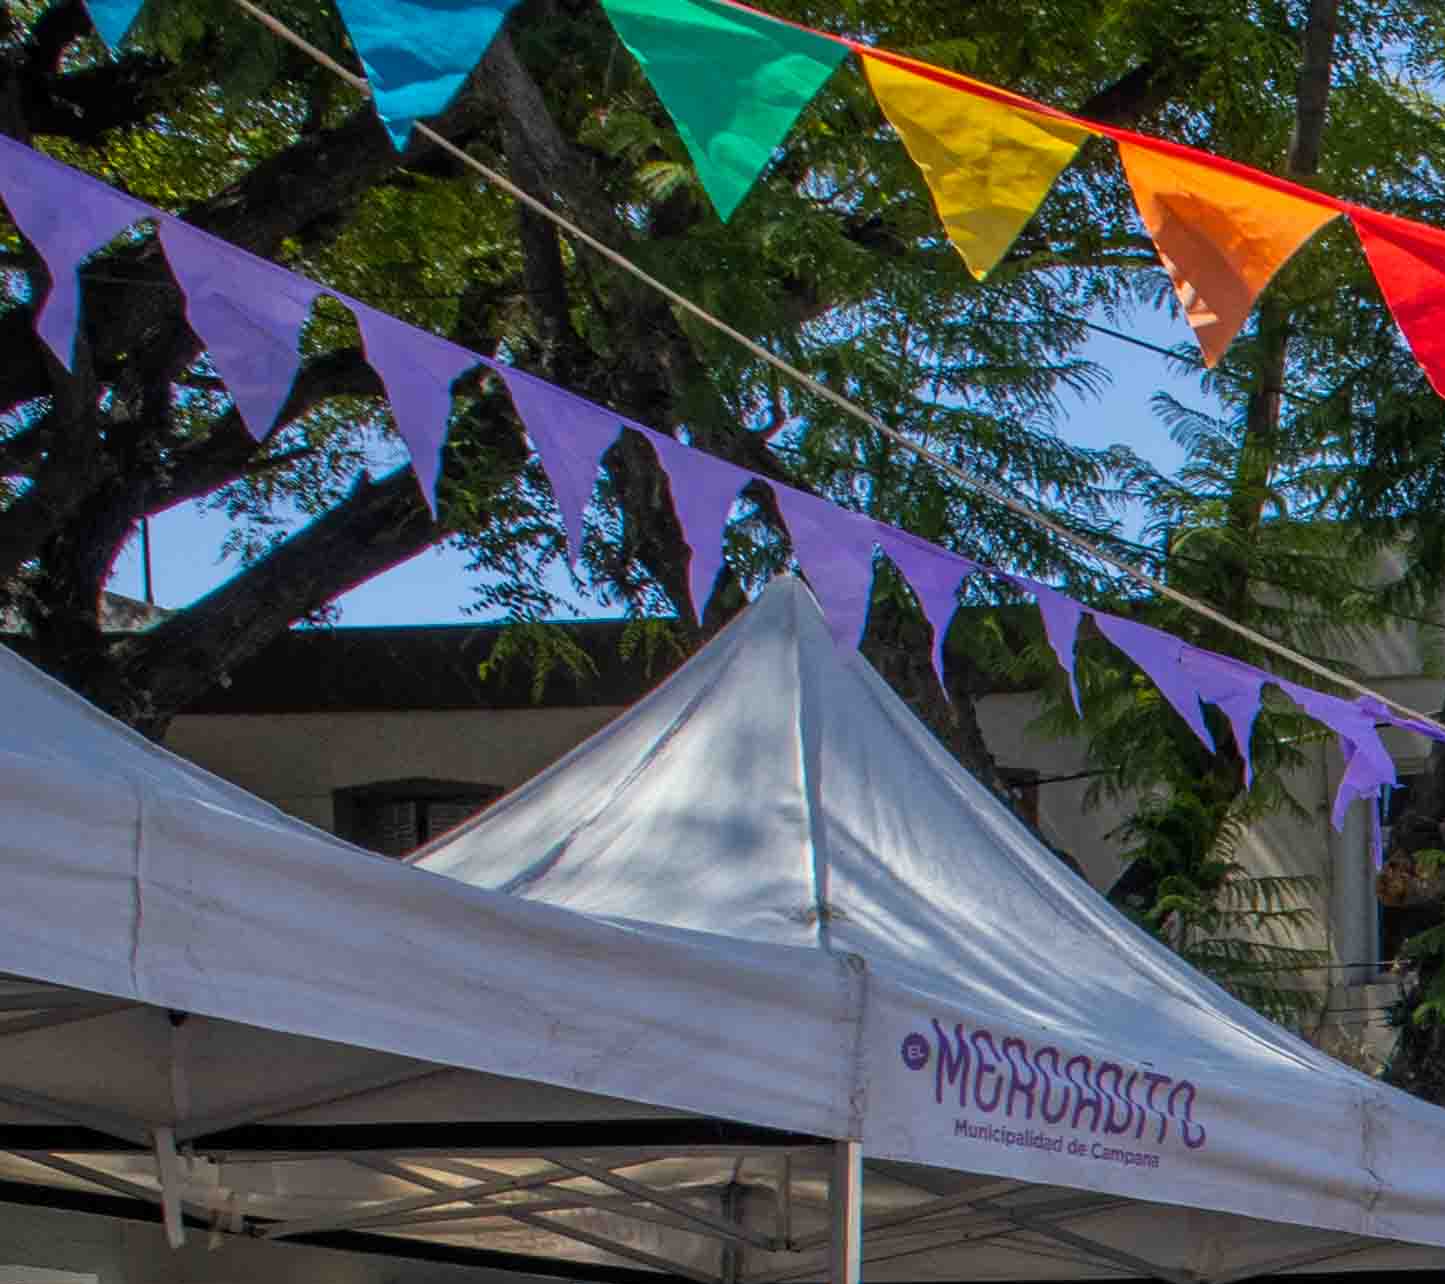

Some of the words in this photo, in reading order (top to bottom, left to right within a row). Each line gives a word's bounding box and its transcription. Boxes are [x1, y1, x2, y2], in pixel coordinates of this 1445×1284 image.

[931, 1017, 1206, 1149] MERCADITO
[954, 1119, 1064, 1153] Municipalidad
[1067, 1139, 1088, 1157] de
[1090, 1142, 1160, 1168] Campana
